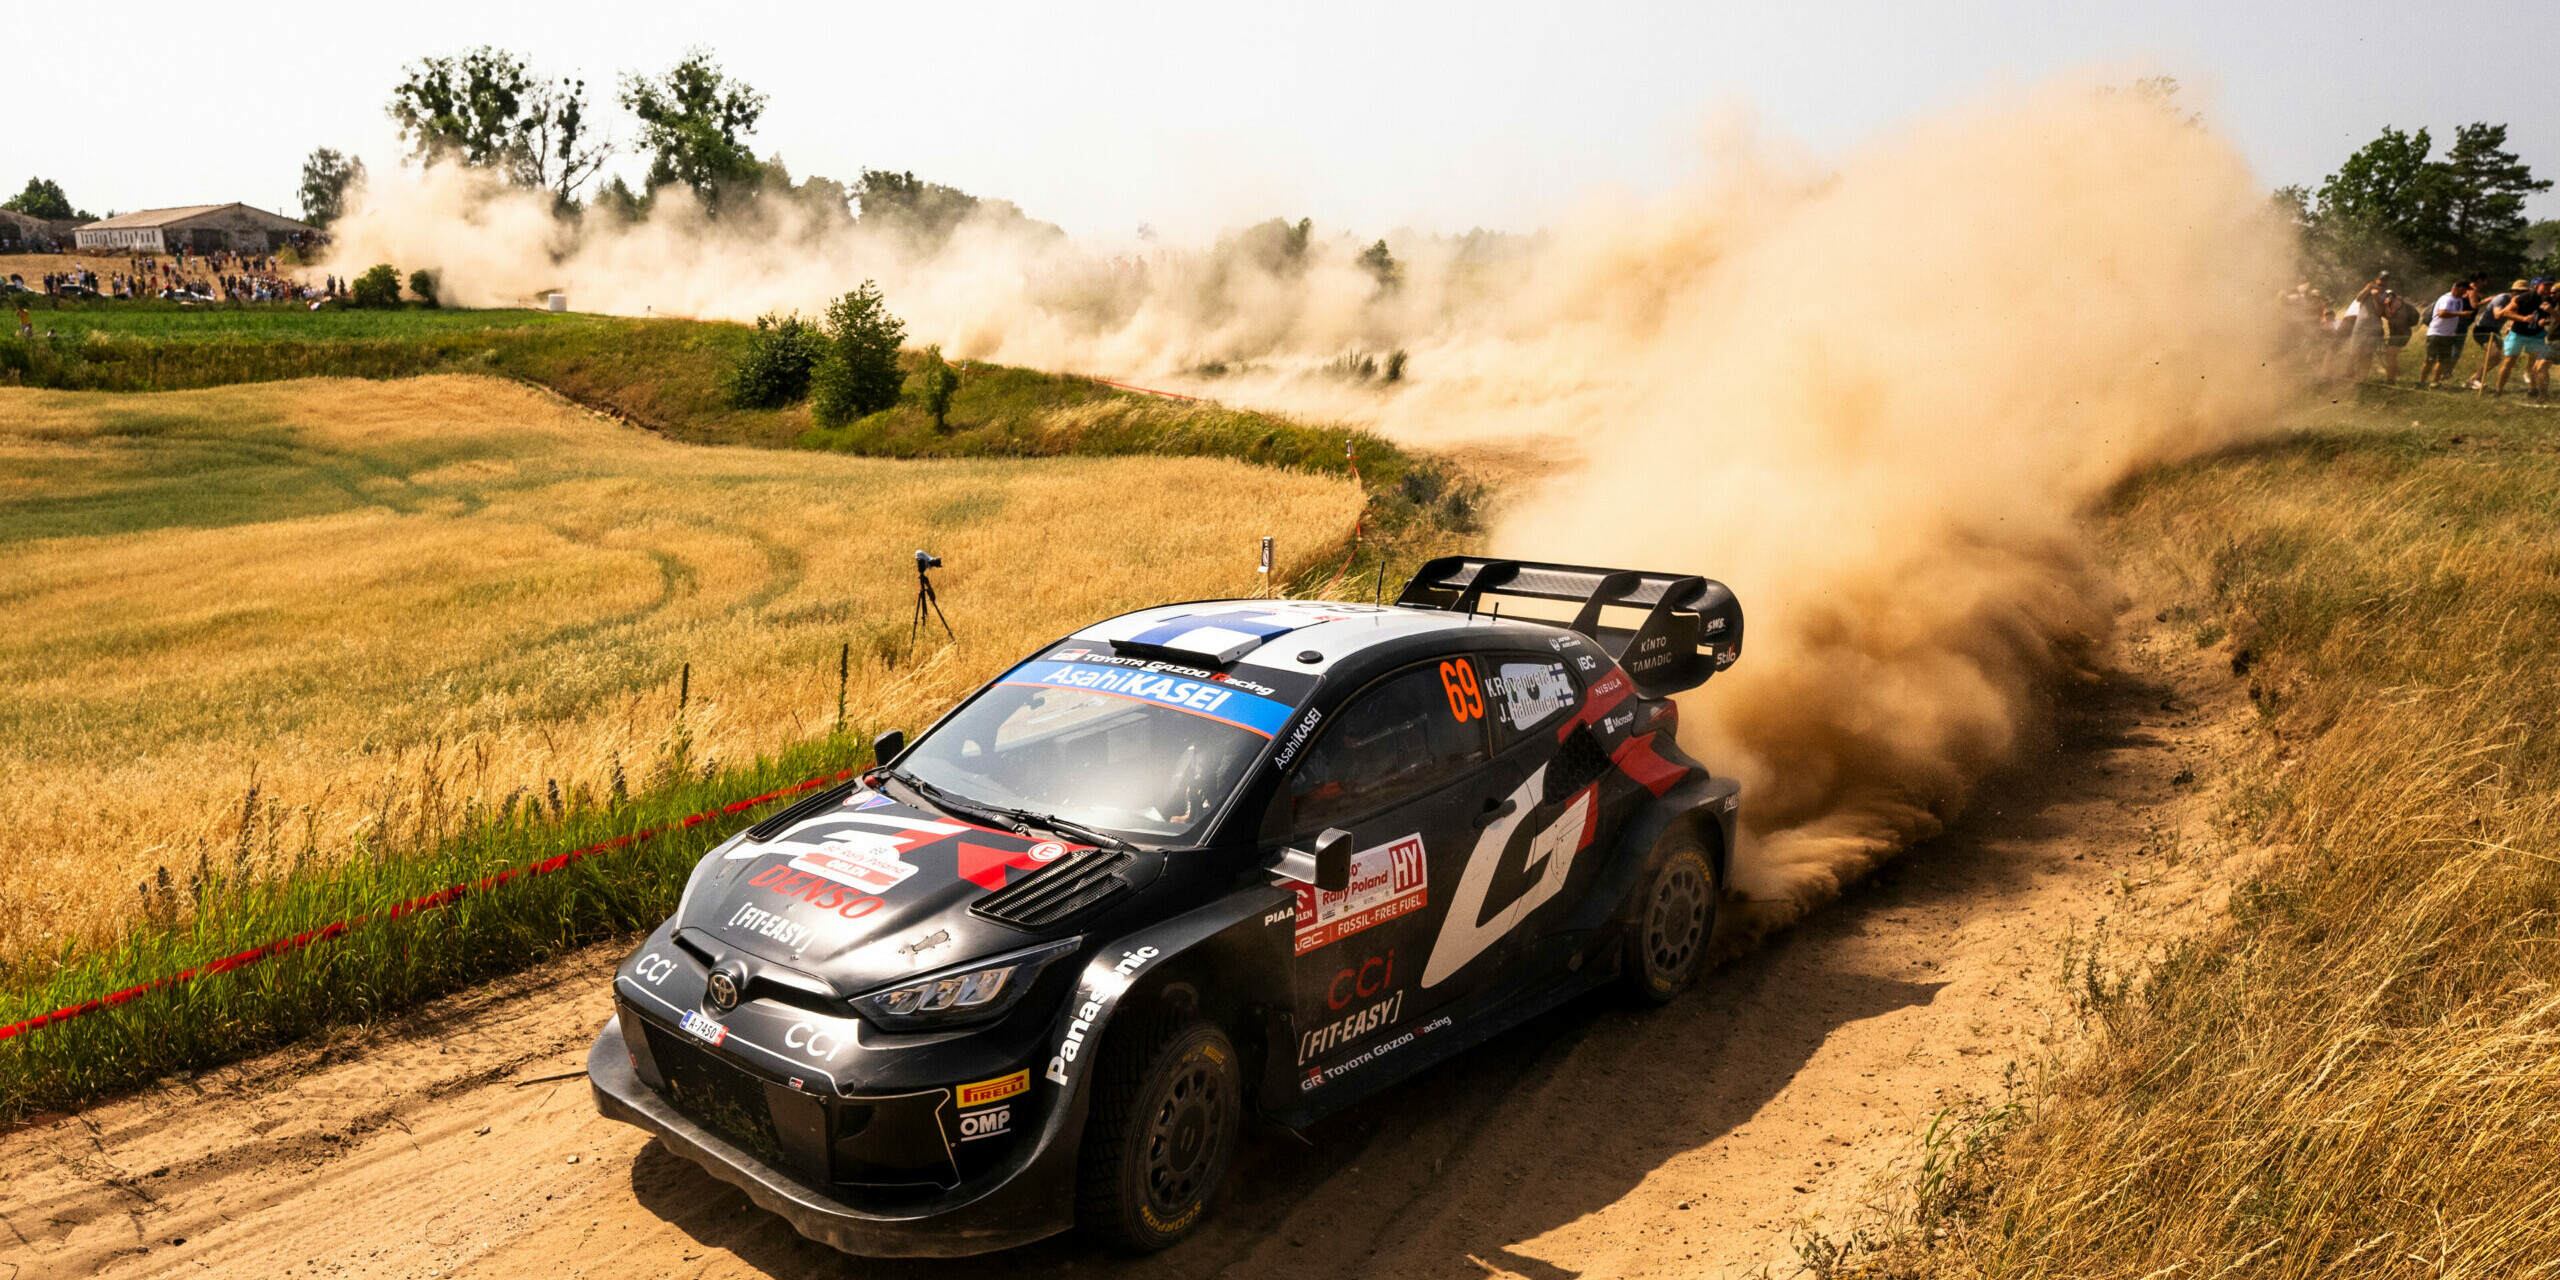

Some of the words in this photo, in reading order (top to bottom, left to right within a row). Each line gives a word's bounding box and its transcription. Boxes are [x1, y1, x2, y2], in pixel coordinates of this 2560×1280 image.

[1716, 645, 1736, 665] Stilo
[1041, 665, 1233, 712] AsahiKASEI
[1083, 653, 1146, 667] TOYOTA
[1146, 661, 1211, 678] GAZOO
[1210, 673, 1276, 696] Racing
[1594, 678, 1622, 696] NISULA
[1440, 658, 1484, 723] 69
[1612, 710, 1634, 728] Microsoft
[1275, 707, 1322, 770] AsahiKASEI
[1038, 846, 1057, 857] E
[1391, 843, 1418, 890] HY
[748, 864, 885, 919] DENSO
[1351, 869, 1388, 895] Poland
[1264, 906, 1295, 927] PIAA
[1338, 902, 1398, 936] FOSSIL-FREE
[1399, 894, 1422, 912] FUEL
[689, 1017, 717, 1039] A-7450
[1301, 1073, 1325, 1091] GR
[1324, 1052, 1374, 1079] TOYOTA
[1373, 1032, 1415, 1057] GAZOO
[1414, 1015, 1452, 1037] Racing
[963, 1075, 1025, 1103] PIRELLI
[960, 1110, 1011, 1136] OMP
